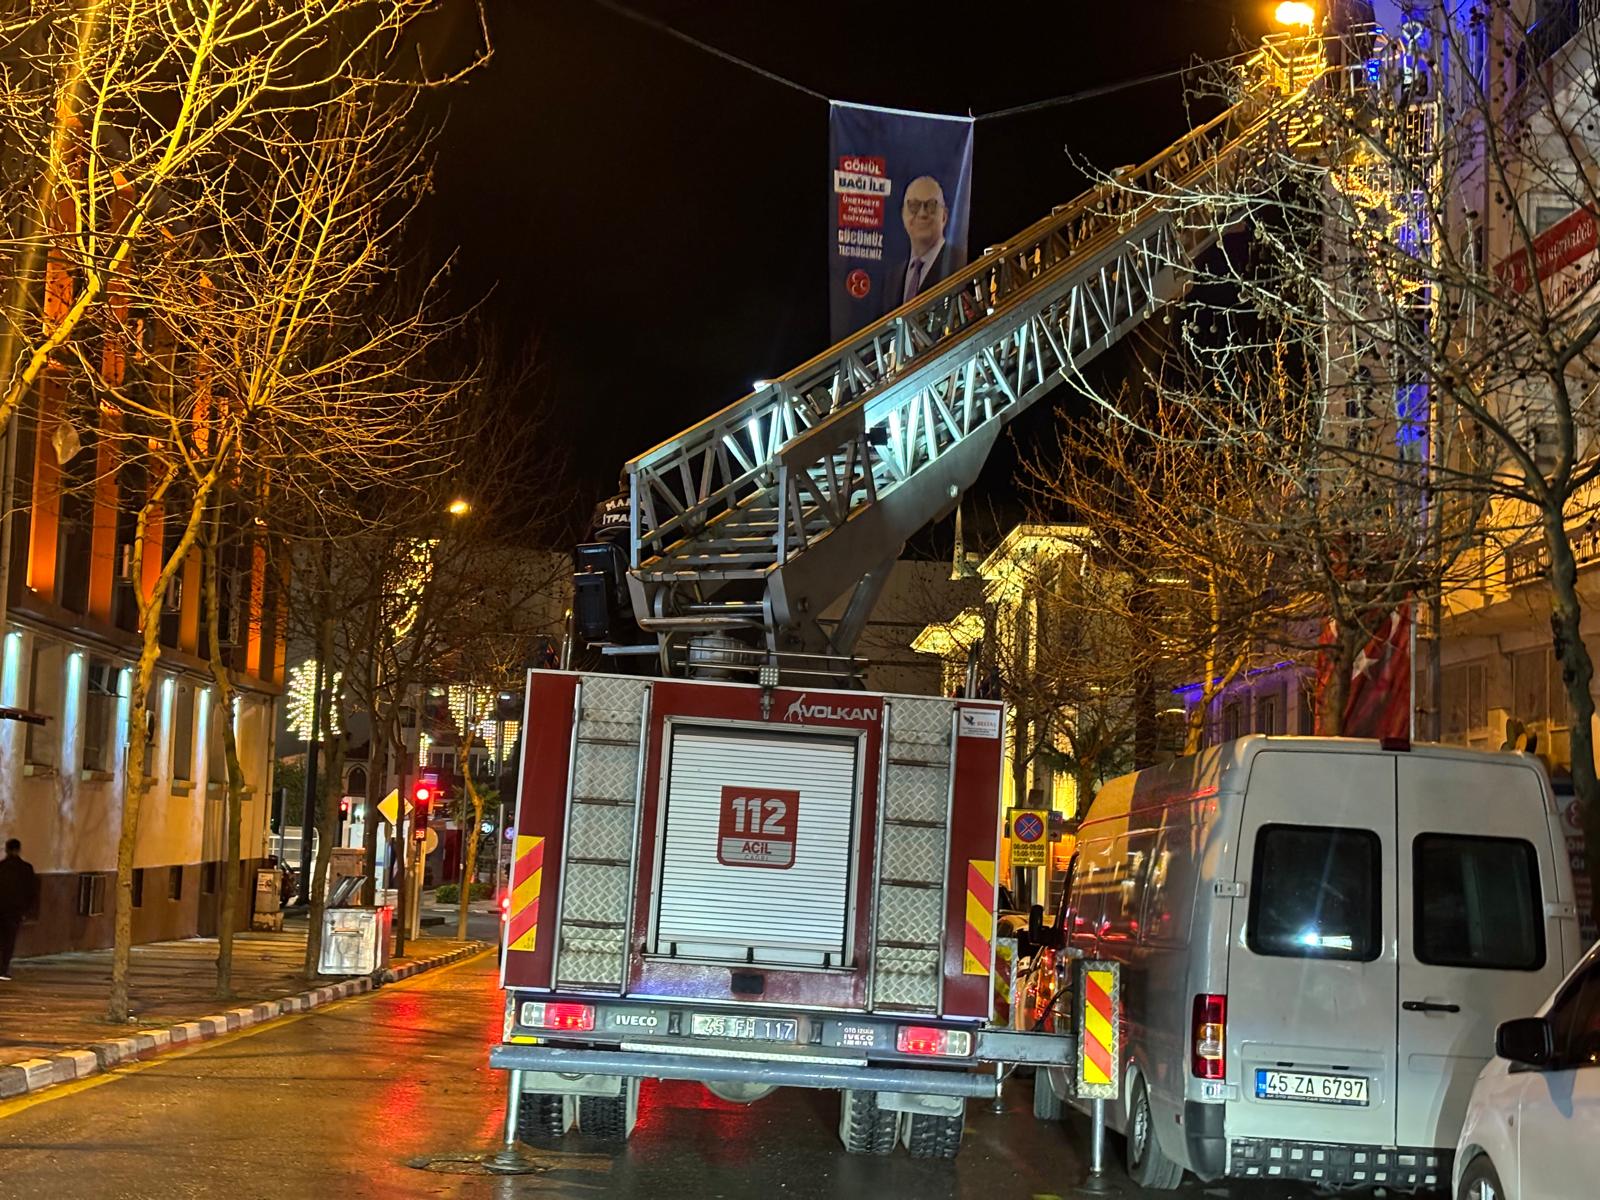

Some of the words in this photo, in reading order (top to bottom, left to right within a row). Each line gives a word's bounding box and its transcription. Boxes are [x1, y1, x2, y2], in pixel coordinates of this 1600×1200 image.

[802, 704, 878, 721] VOLKAN
[731, 796, 787, 835] 112
[615, 1014, 658, 1027] IVECO
[703, 1018, 726, 1034] 45
[735, 1020, 756, 1038] FH
[764, 1022, 794, 1039] 117
[843, 1033, 875, 1041] IVECO
[1268, 1074, 1288, 1092] 45
[1294, 1077, 1315, 1095] ZA
[1322, 1078, 1363, 1098] 6797
